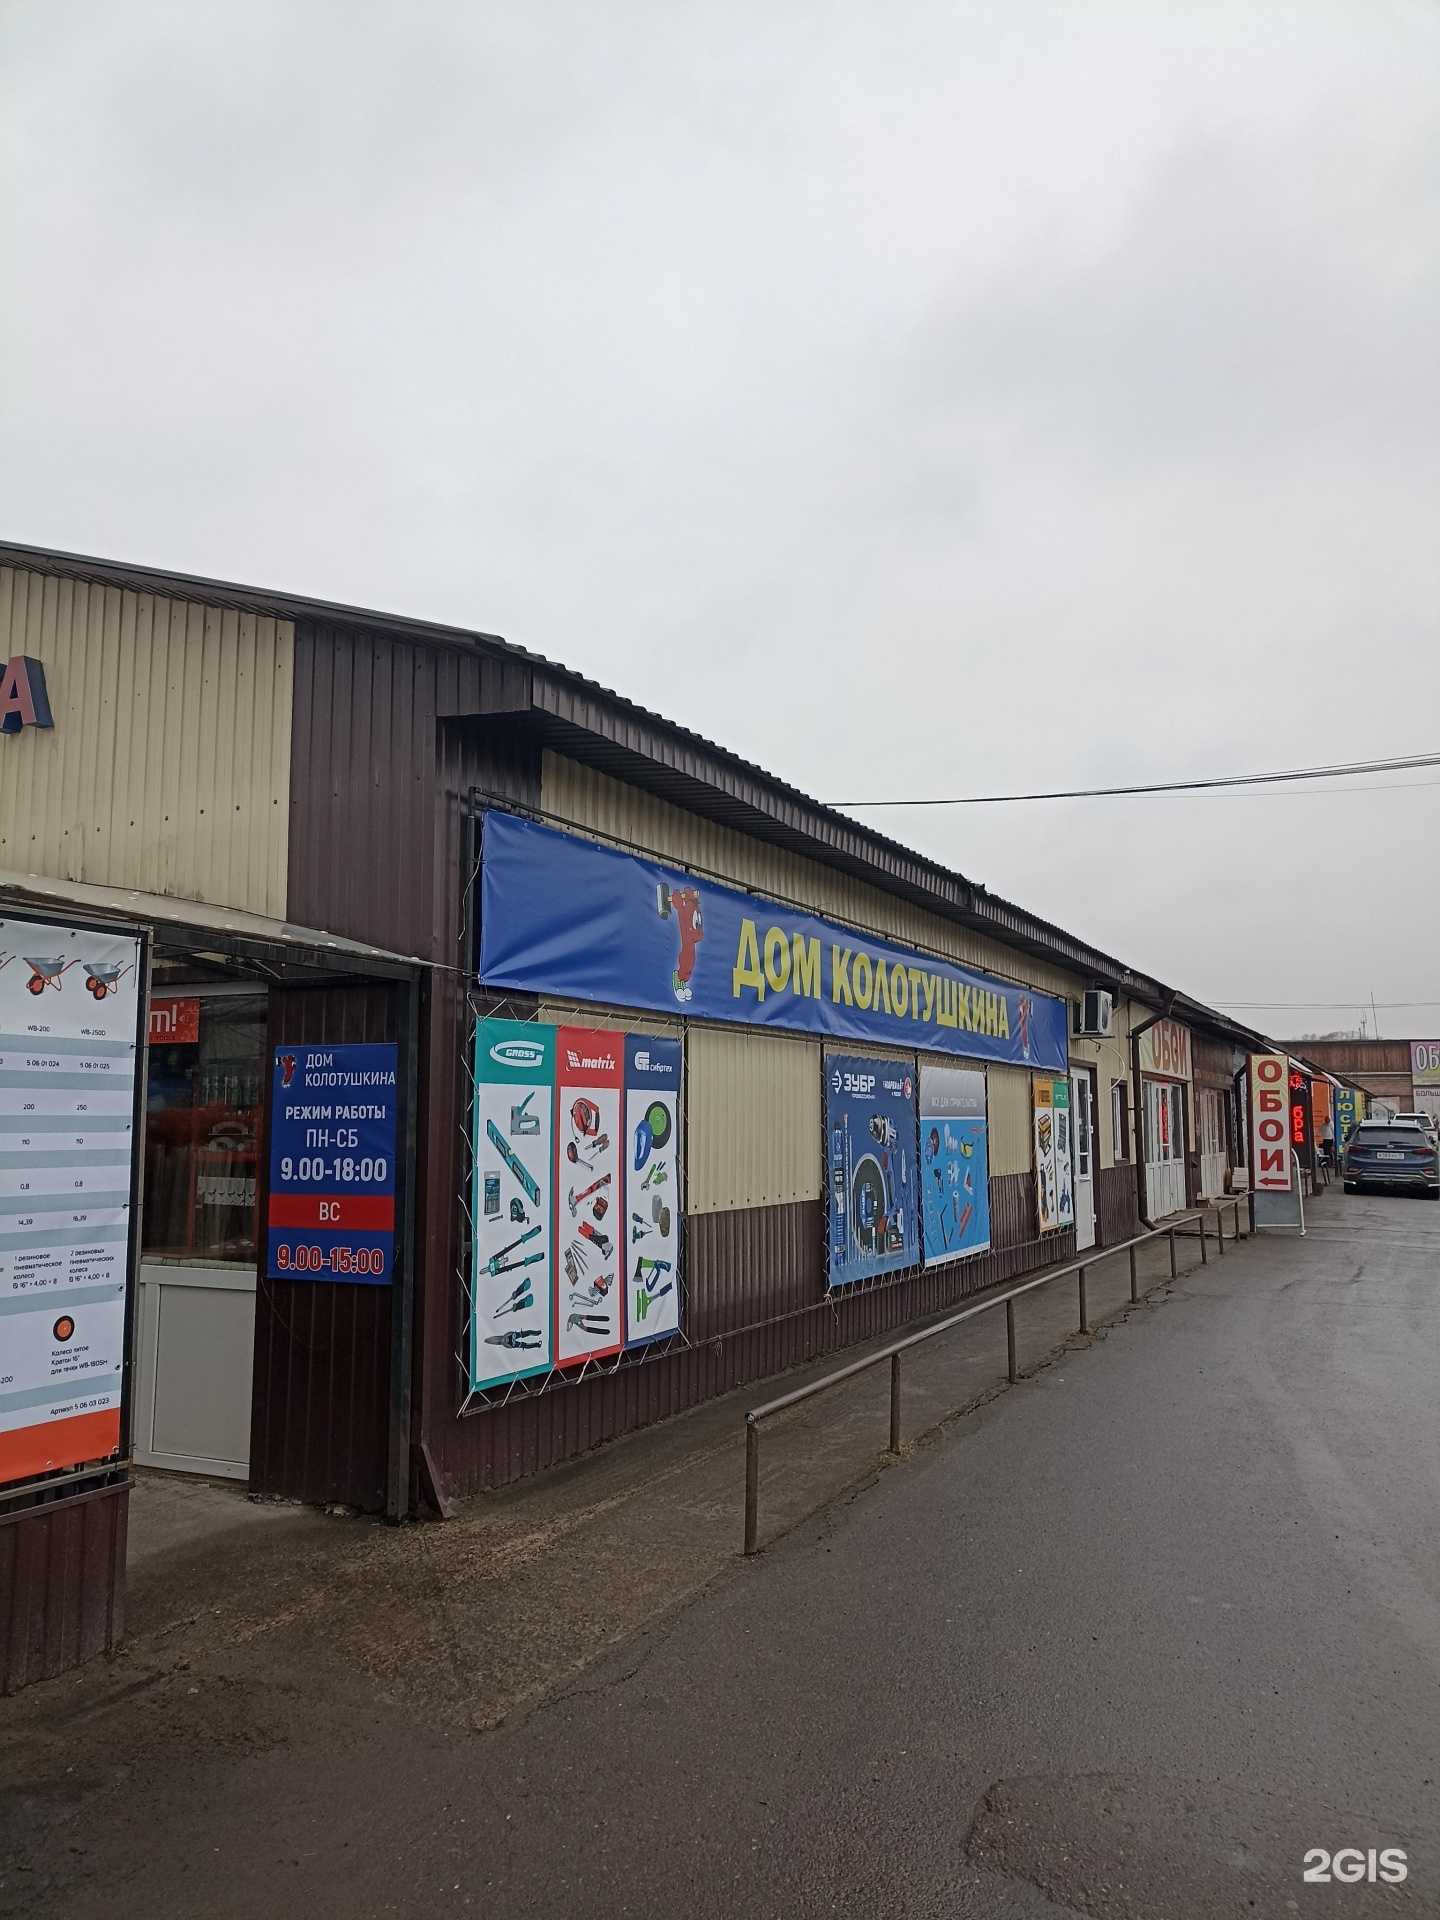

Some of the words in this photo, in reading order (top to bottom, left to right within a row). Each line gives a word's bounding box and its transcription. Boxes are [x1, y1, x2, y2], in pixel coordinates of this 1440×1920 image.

[732, 918, 822, 1002] ДОМ
[832, 944, 1010, 1040] КОЛОТУШКИНА
[1152, 1020, 1188, 1076] ОБОИ
[305, 1053, 334, 1069] ДОМ
[581, 1053, 616, 1070] matrix
[649, 1062, 673, 1073] сибртех
[305, 1071, 396, 1087] КОЛОТУШКИНА
[844, 1073, 876, 1092] ЗУБР
[285, 1106, 332, 1120] РЕЖИМ
[335, 1105, 386, 1120] РАБОТЫ
[1257, 1060, 1285, 1172] ОБОИ
[1293, 1106, 1304, 1142] бра
[306, 1128, 359, 1148] ПН-СБ
[280, 1157, 387, 1182] 9.00-18:00
[319, 1202, 340, 1222] ВС
[18, 1253, 50, 1262] резиновое
[277, 1244, 384, 1275] 9.00-15:00
[51, 1348, 72, 1357] Колесо
[51, 1358, 72, 1366] Кратон
[50, 1406, 74, 1416] Артикул
